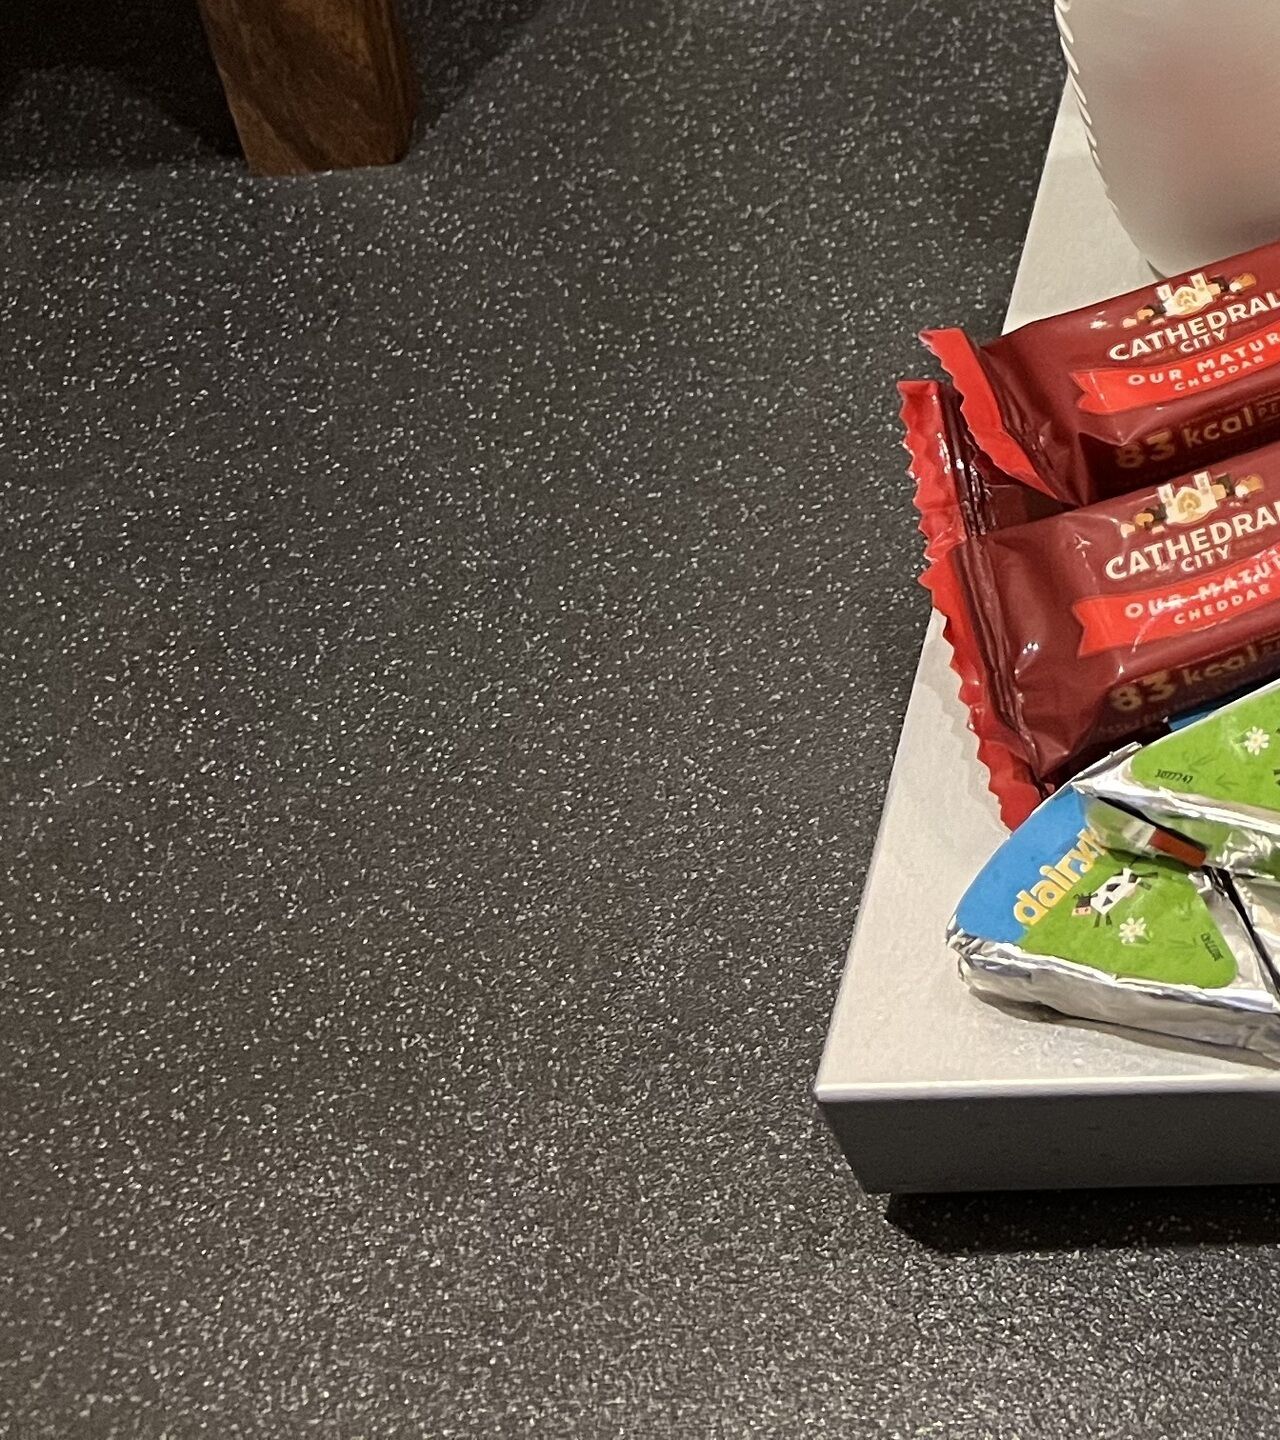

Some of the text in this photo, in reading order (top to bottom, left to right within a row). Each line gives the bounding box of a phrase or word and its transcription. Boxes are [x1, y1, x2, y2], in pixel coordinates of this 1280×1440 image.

[1180, 328, 1227, 353] CITY
[1127, 369, 1183, 386] OUR
[1174, 355, 1264, 392] CHEDDAR
[1182, 407, 1253, 449] kcal
[1181, 544, 1232, 572] CITY
[1124, 594, 1184, 618] OUR
[1174, 583, 1271, 625] CHEDDAR
[1182, 645, 1257, 686] kcal
[1013, 827, 1105, 925] dairyl
